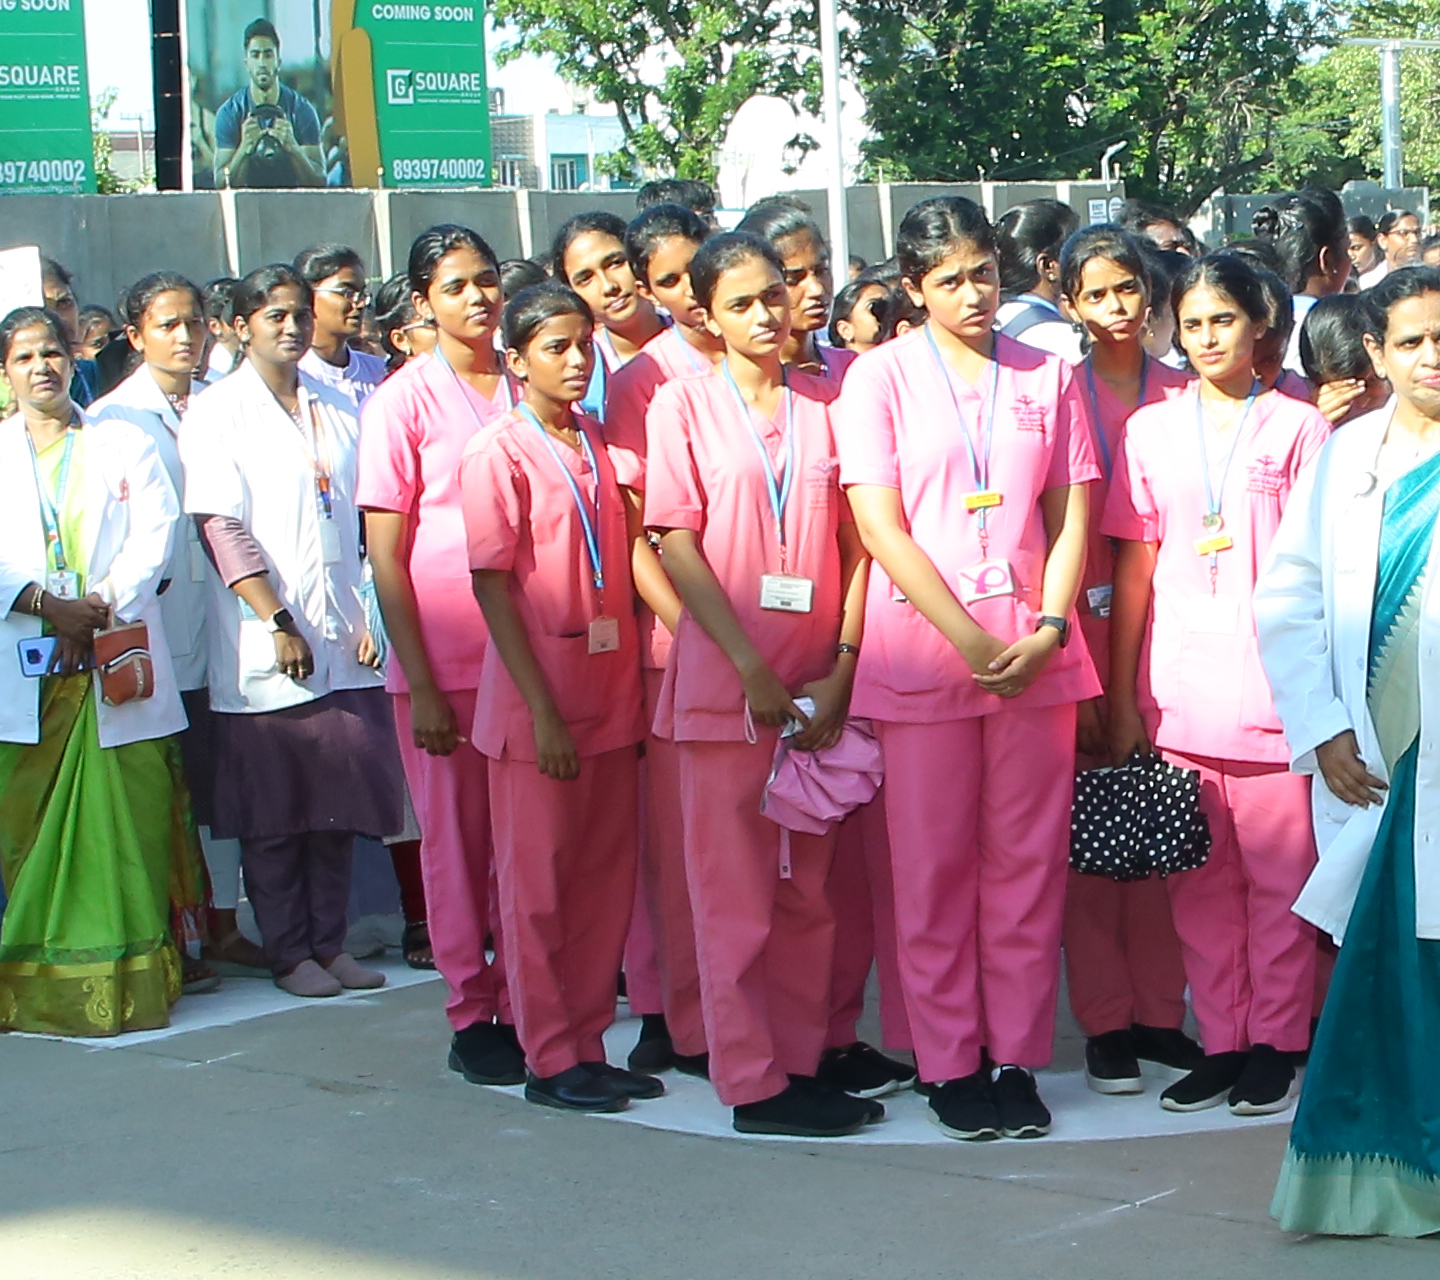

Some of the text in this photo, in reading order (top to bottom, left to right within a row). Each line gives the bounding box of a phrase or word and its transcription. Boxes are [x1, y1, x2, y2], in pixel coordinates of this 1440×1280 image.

[372, 4, 474, 22] COMING SOON
[395, 72, 481, 96] G SQUARE
[393, 158, 486, 180] 8939740002
